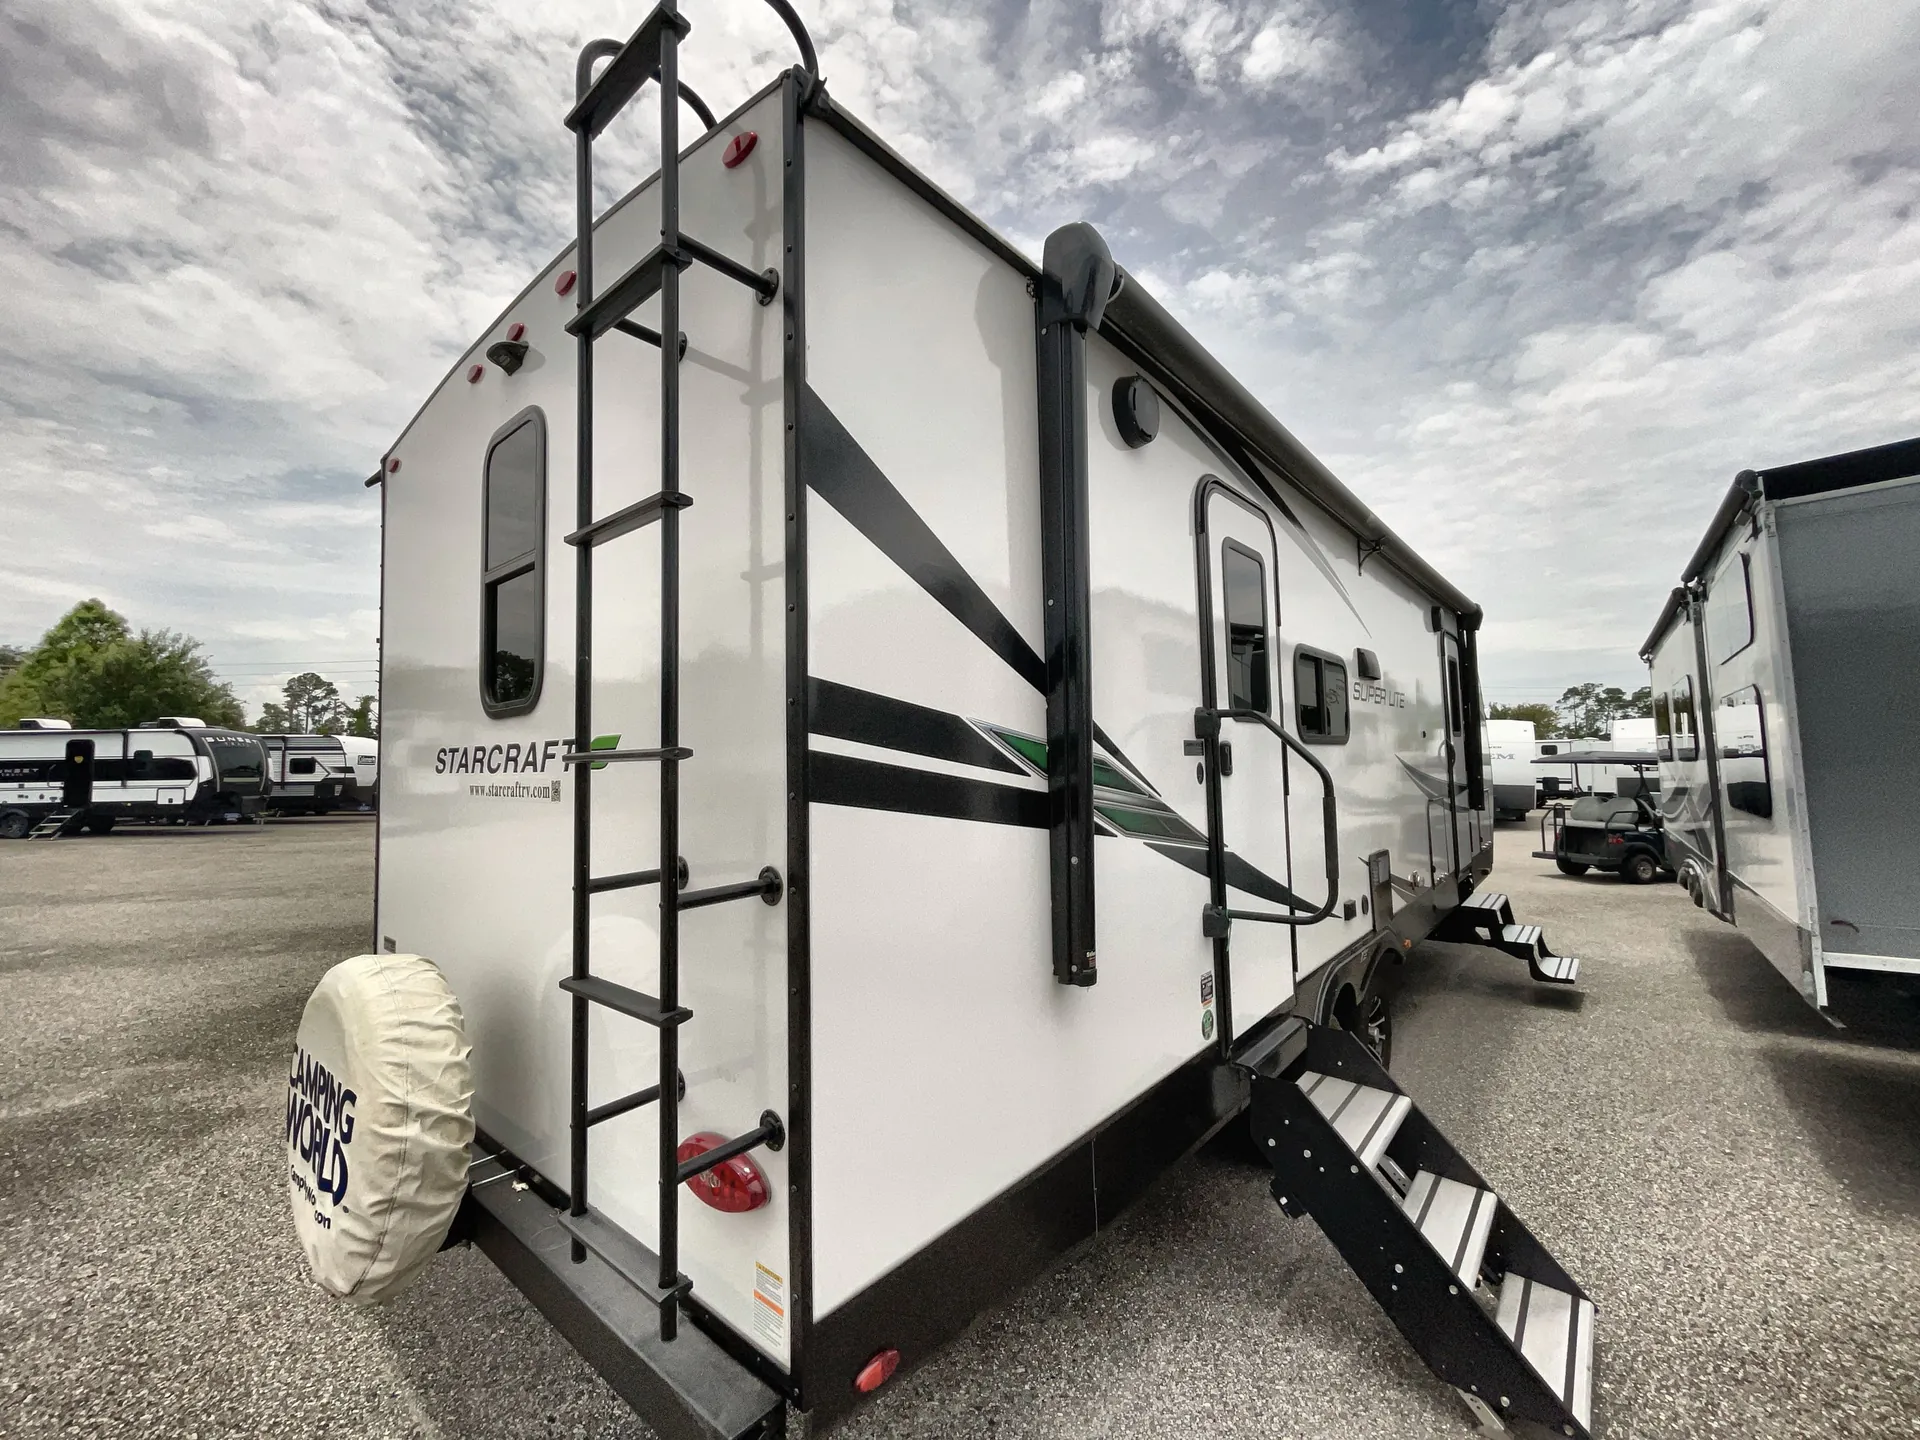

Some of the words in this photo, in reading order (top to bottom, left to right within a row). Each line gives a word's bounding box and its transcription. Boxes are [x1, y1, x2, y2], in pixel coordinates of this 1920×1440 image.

[1353, 681, 1386, 705] SUPER
[1389, 690, 1405, 709] LITE
[205, 737, 257, 745] SUNSET
[435, 738, 576, 775] STARCRAFT
[469, 781, 550, 799] www.starcraftrv.com
[289, 1043, 357, 1145] CAMPING
[286, 1086, 348, 1207] WORLD
